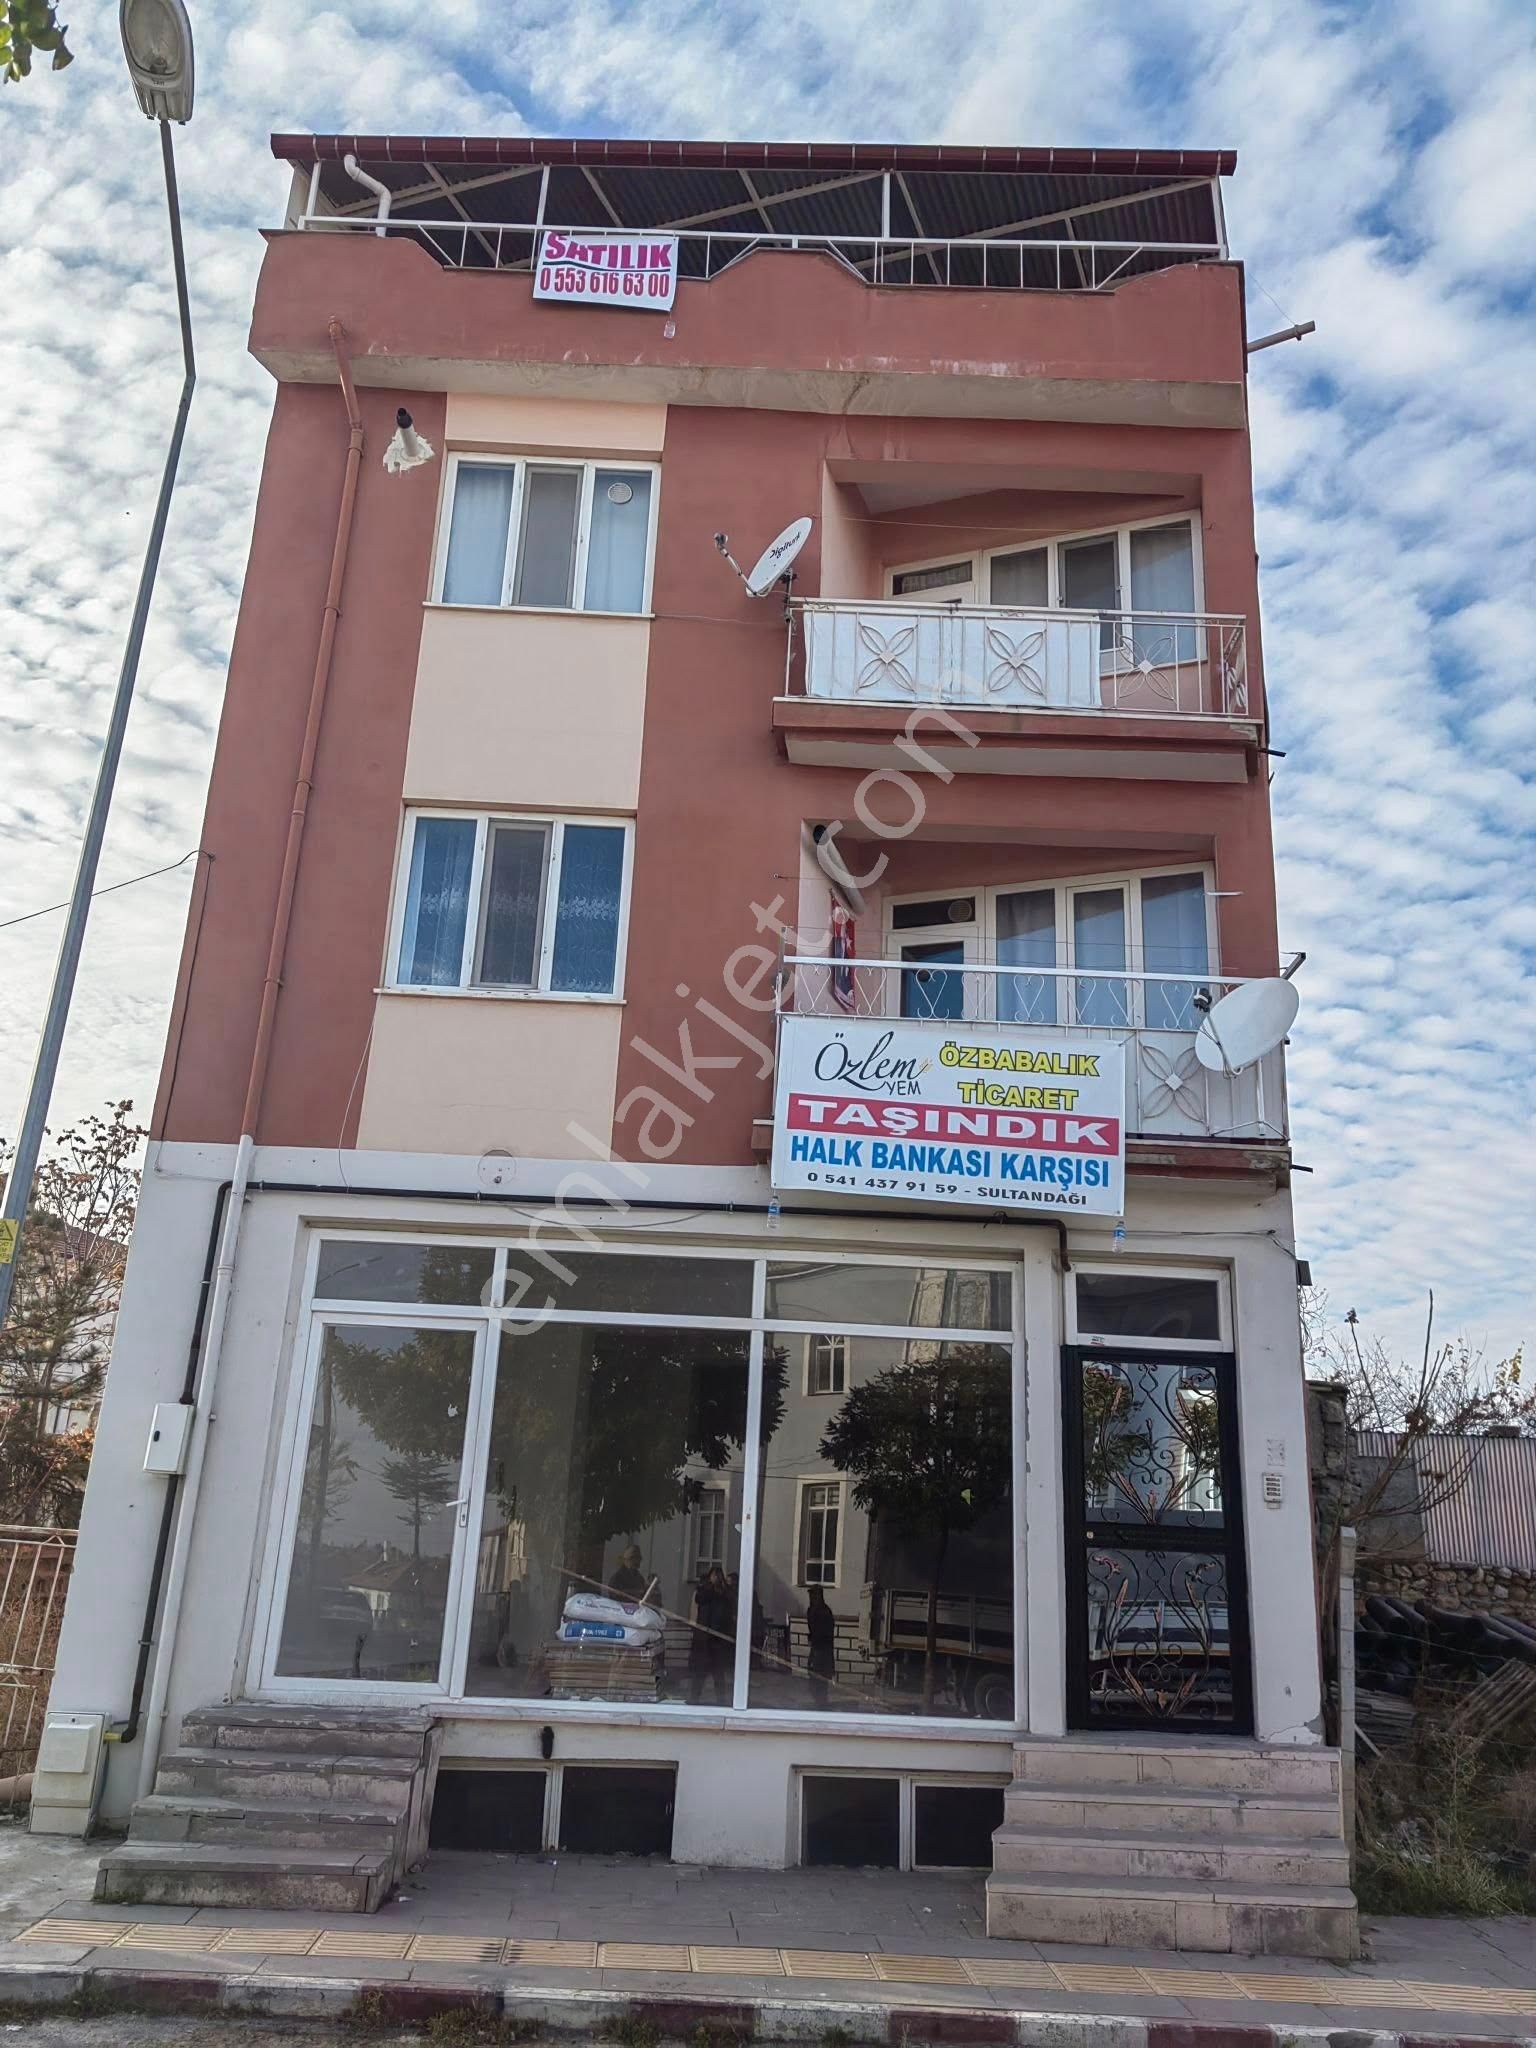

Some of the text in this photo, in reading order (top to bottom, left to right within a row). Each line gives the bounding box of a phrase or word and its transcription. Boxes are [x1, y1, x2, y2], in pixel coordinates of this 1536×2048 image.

[545, 232, 672, 269] SATILIK
[540, 267, 670, 298] 0 553 616 63 00
[814, 1031, 929, 1091] Özlem
[940, 1041, 1101, 1077] ÖZBABALIK
[886, 1080, 922, 1096] YEM
[957, 1079, 1079, 1112] TİCARET
[798, 1099, 1110, 1147] TAŞINDIK
[791, 1135, 1109, 1191] HALK BANKASI KARŞISI
[807, 1172, 818, 1182] 0
[825, 1174, 856, 1186] 541
[865, 1178, 898, 1190] 437
[906, 1181, 927, 1192] 91
[935, 1184, 958, 1194] 59
[977, 1186, 1087, 1205] SULTANDAĞI
